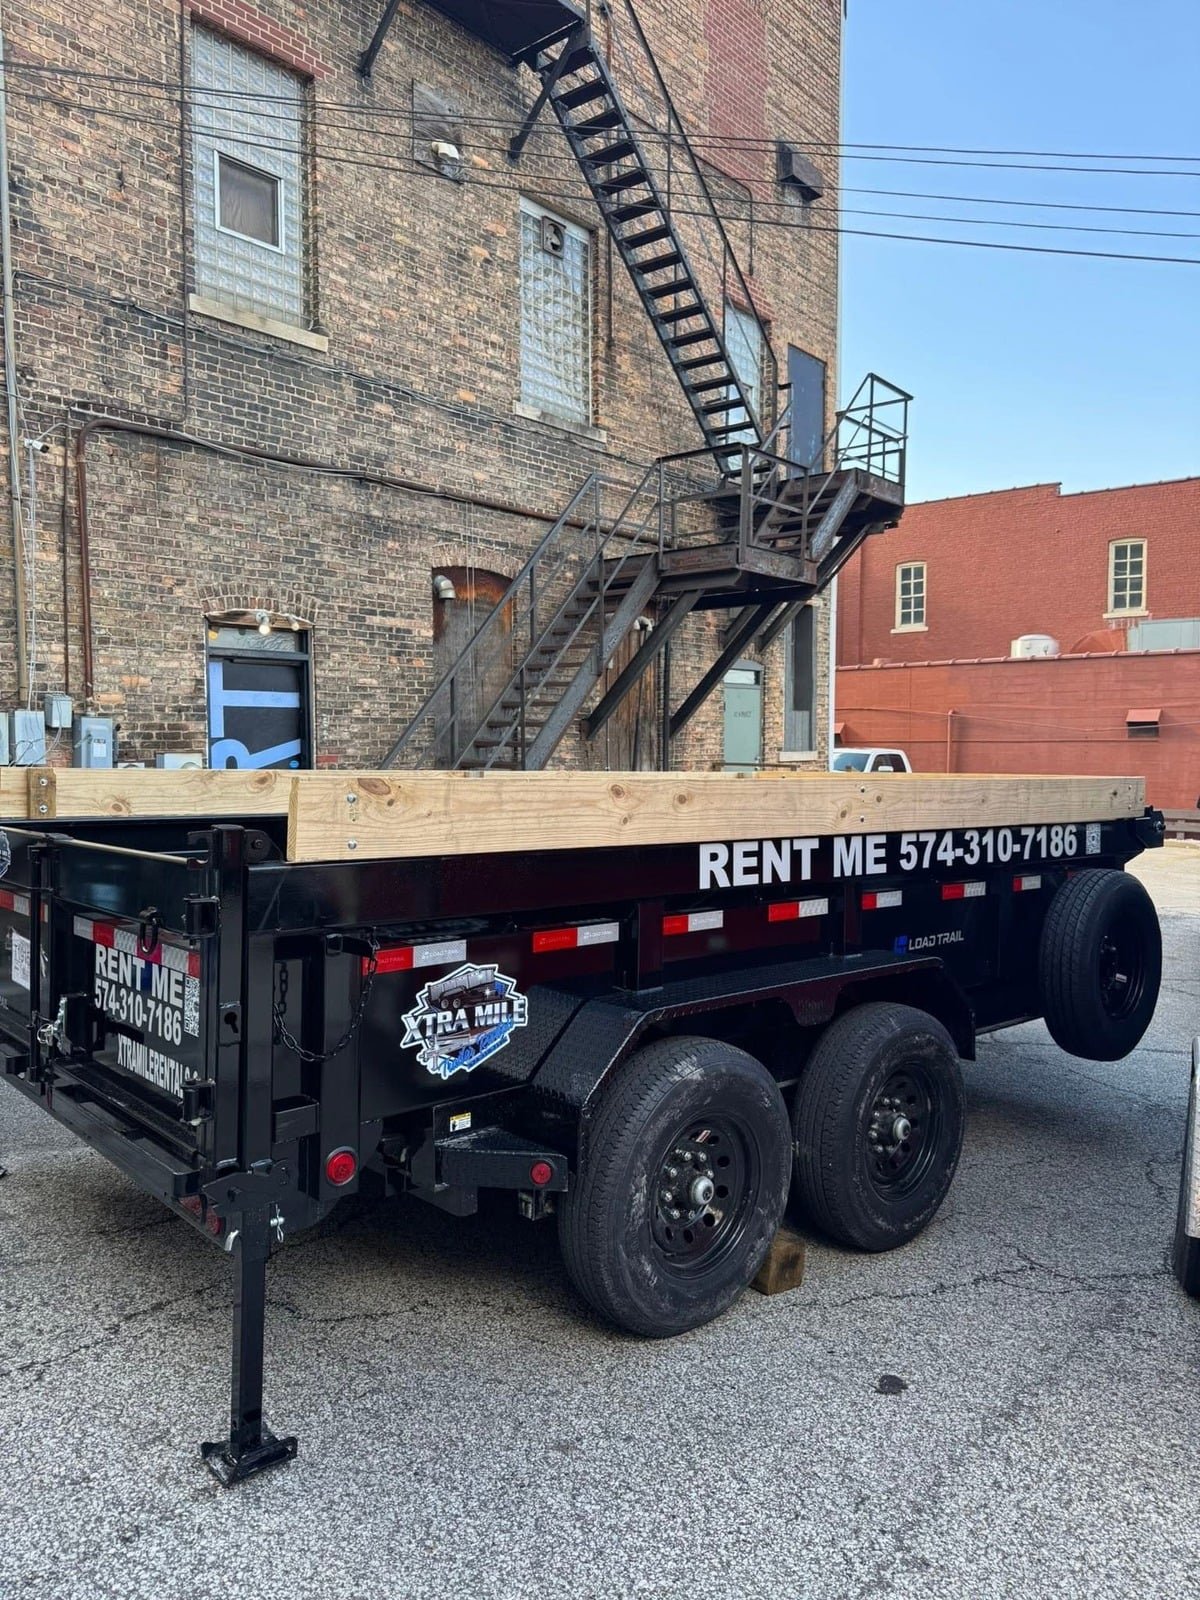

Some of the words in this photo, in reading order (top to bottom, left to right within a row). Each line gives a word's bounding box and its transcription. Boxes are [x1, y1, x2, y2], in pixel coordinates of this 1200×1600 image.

[699, 837, 820, 890] RENT
[833, 834, 887, 878] ME
[899, 823, 1077, 871] 574-310-7186
[95, 943, 145, 992] RENT
[151, 963, 183, 1009] ME
[94, 977, 182, 1046] 574-310-7186
[405, 1008, 470, 1042] XTRA
[474, 999, 526, 1028] MILE
